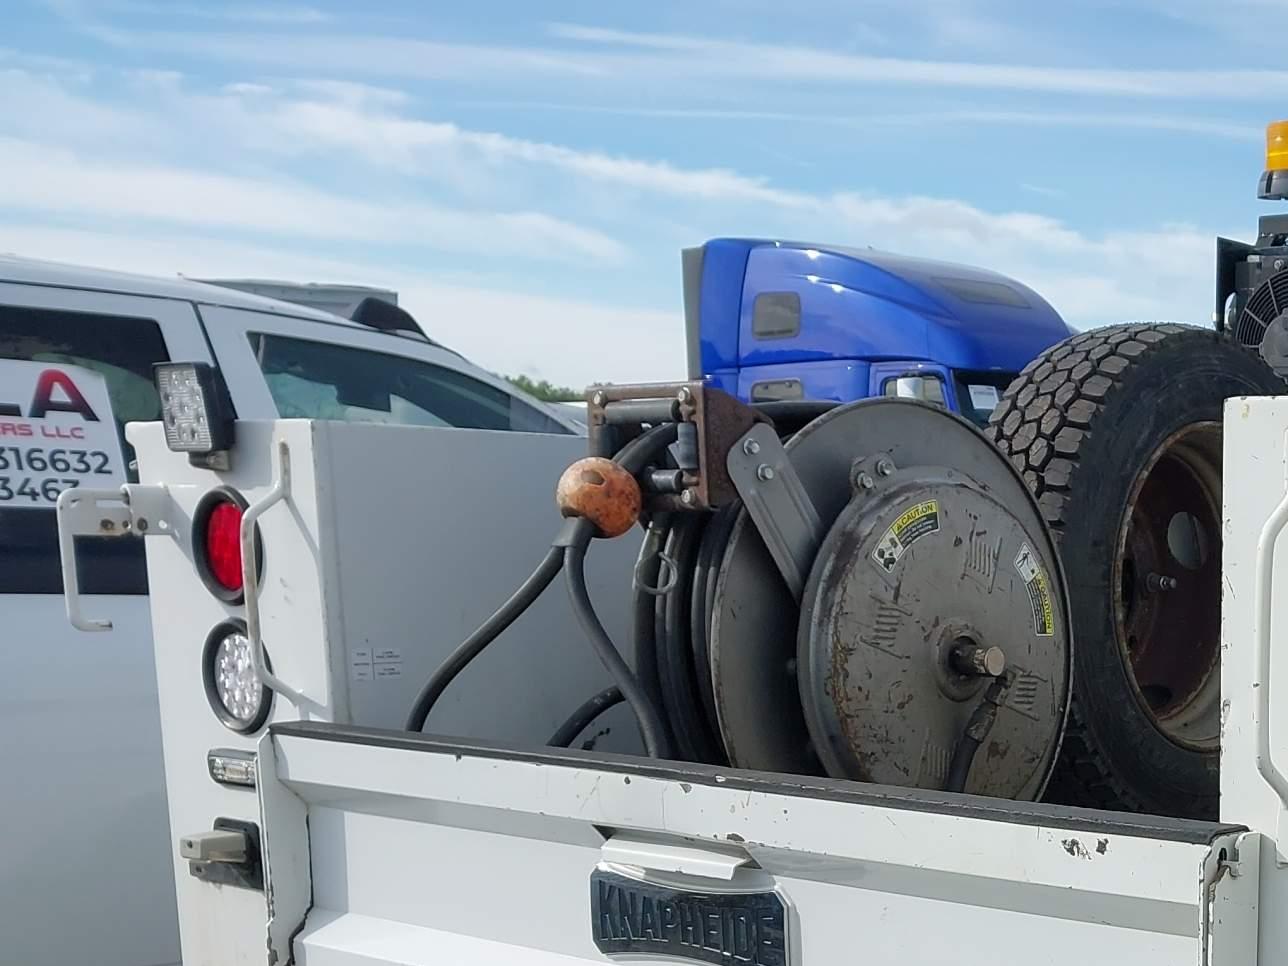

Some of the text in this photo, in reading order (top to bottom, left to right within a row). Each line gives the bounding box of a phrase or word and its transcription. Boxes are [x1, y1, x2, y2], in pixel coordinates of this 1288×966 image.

[0, 423, 85, 439] RS LLC
[901, 504, 933, 525] CAUTION
[1040, 586, 1053, 630] CAUTION
